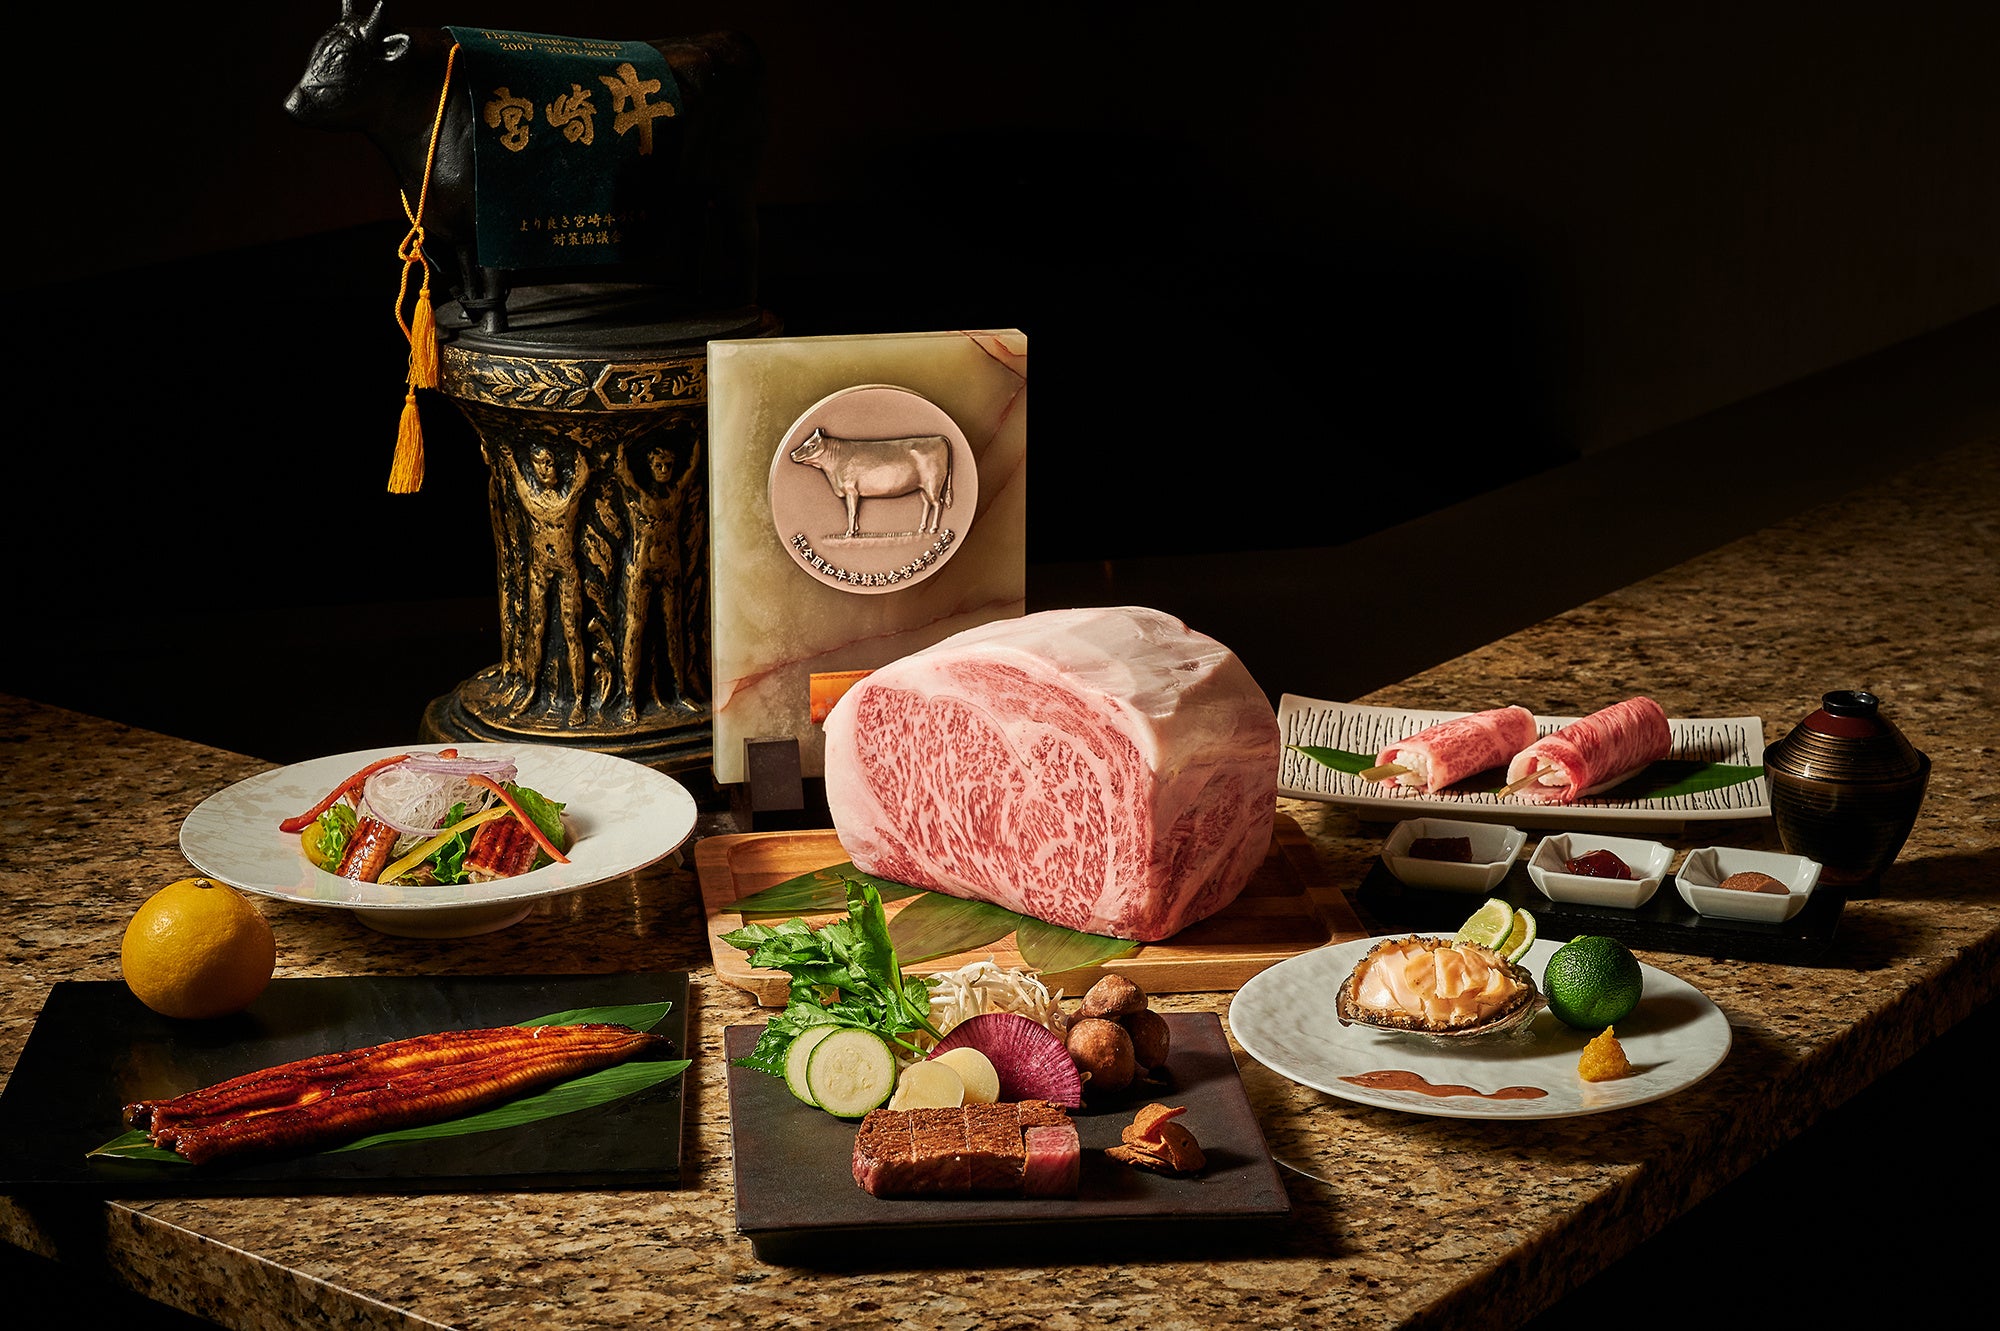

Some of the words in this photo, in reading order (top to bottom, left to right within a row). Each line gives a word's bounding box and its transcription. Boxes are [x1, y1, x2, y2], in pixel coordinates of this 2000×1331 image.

[481, 30, 511, 41] The
[512, 33, 580, 48] Champion
[582, 41, 622, 51] Brand
[482, 62, 675, 156] 宮崎牛
[551, 229, 623, 248] 対策協議会
